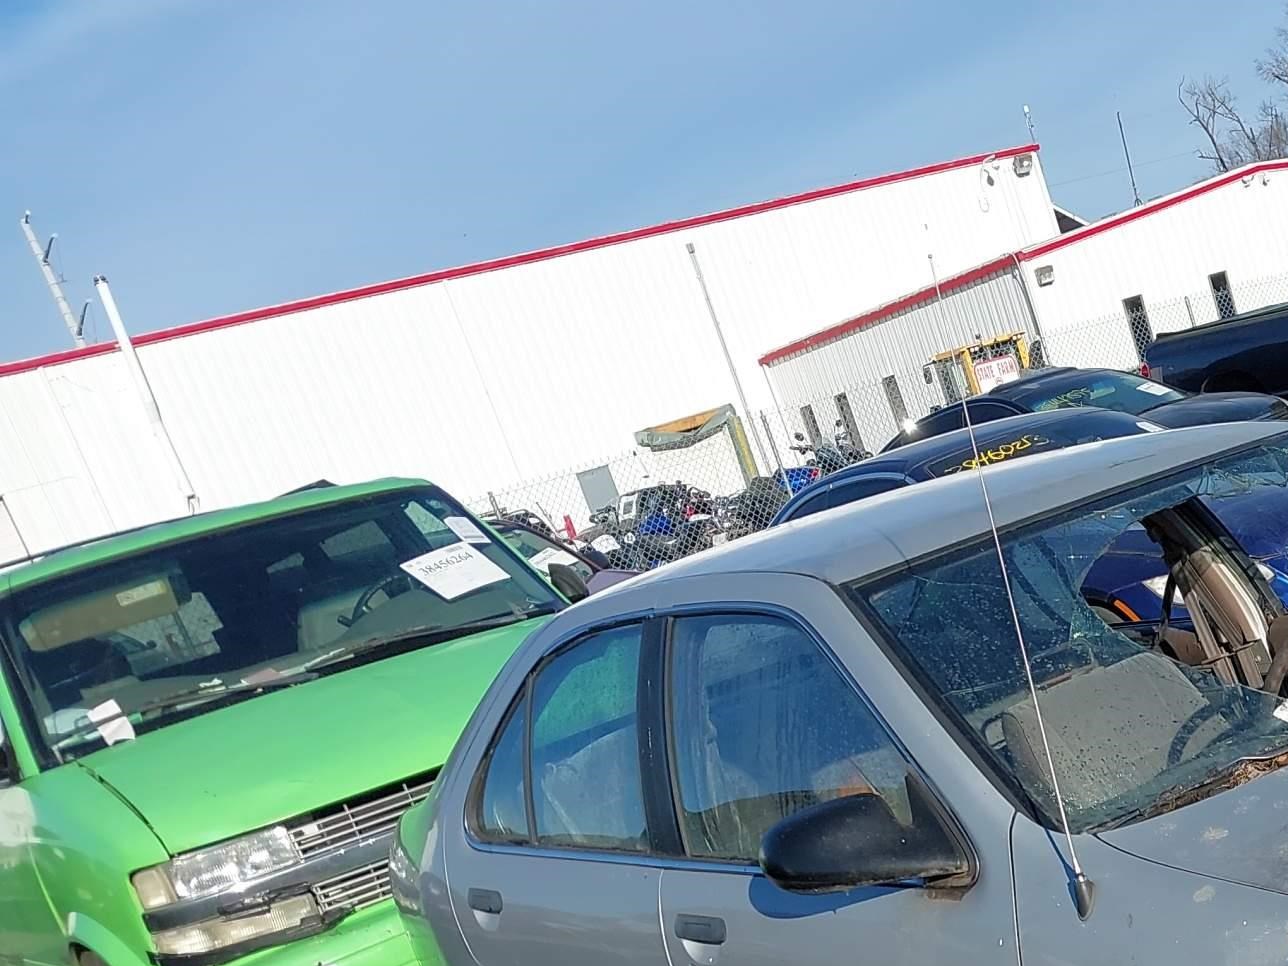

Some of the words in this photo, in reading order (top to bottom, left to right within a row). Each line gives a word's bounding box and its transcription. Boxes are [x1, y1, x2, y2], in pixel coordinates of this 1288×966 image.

[976, 365, 995, 382] STATE
[996, 359, 1016, 377] FARM
[419, 551, 475, 577] 38456264
